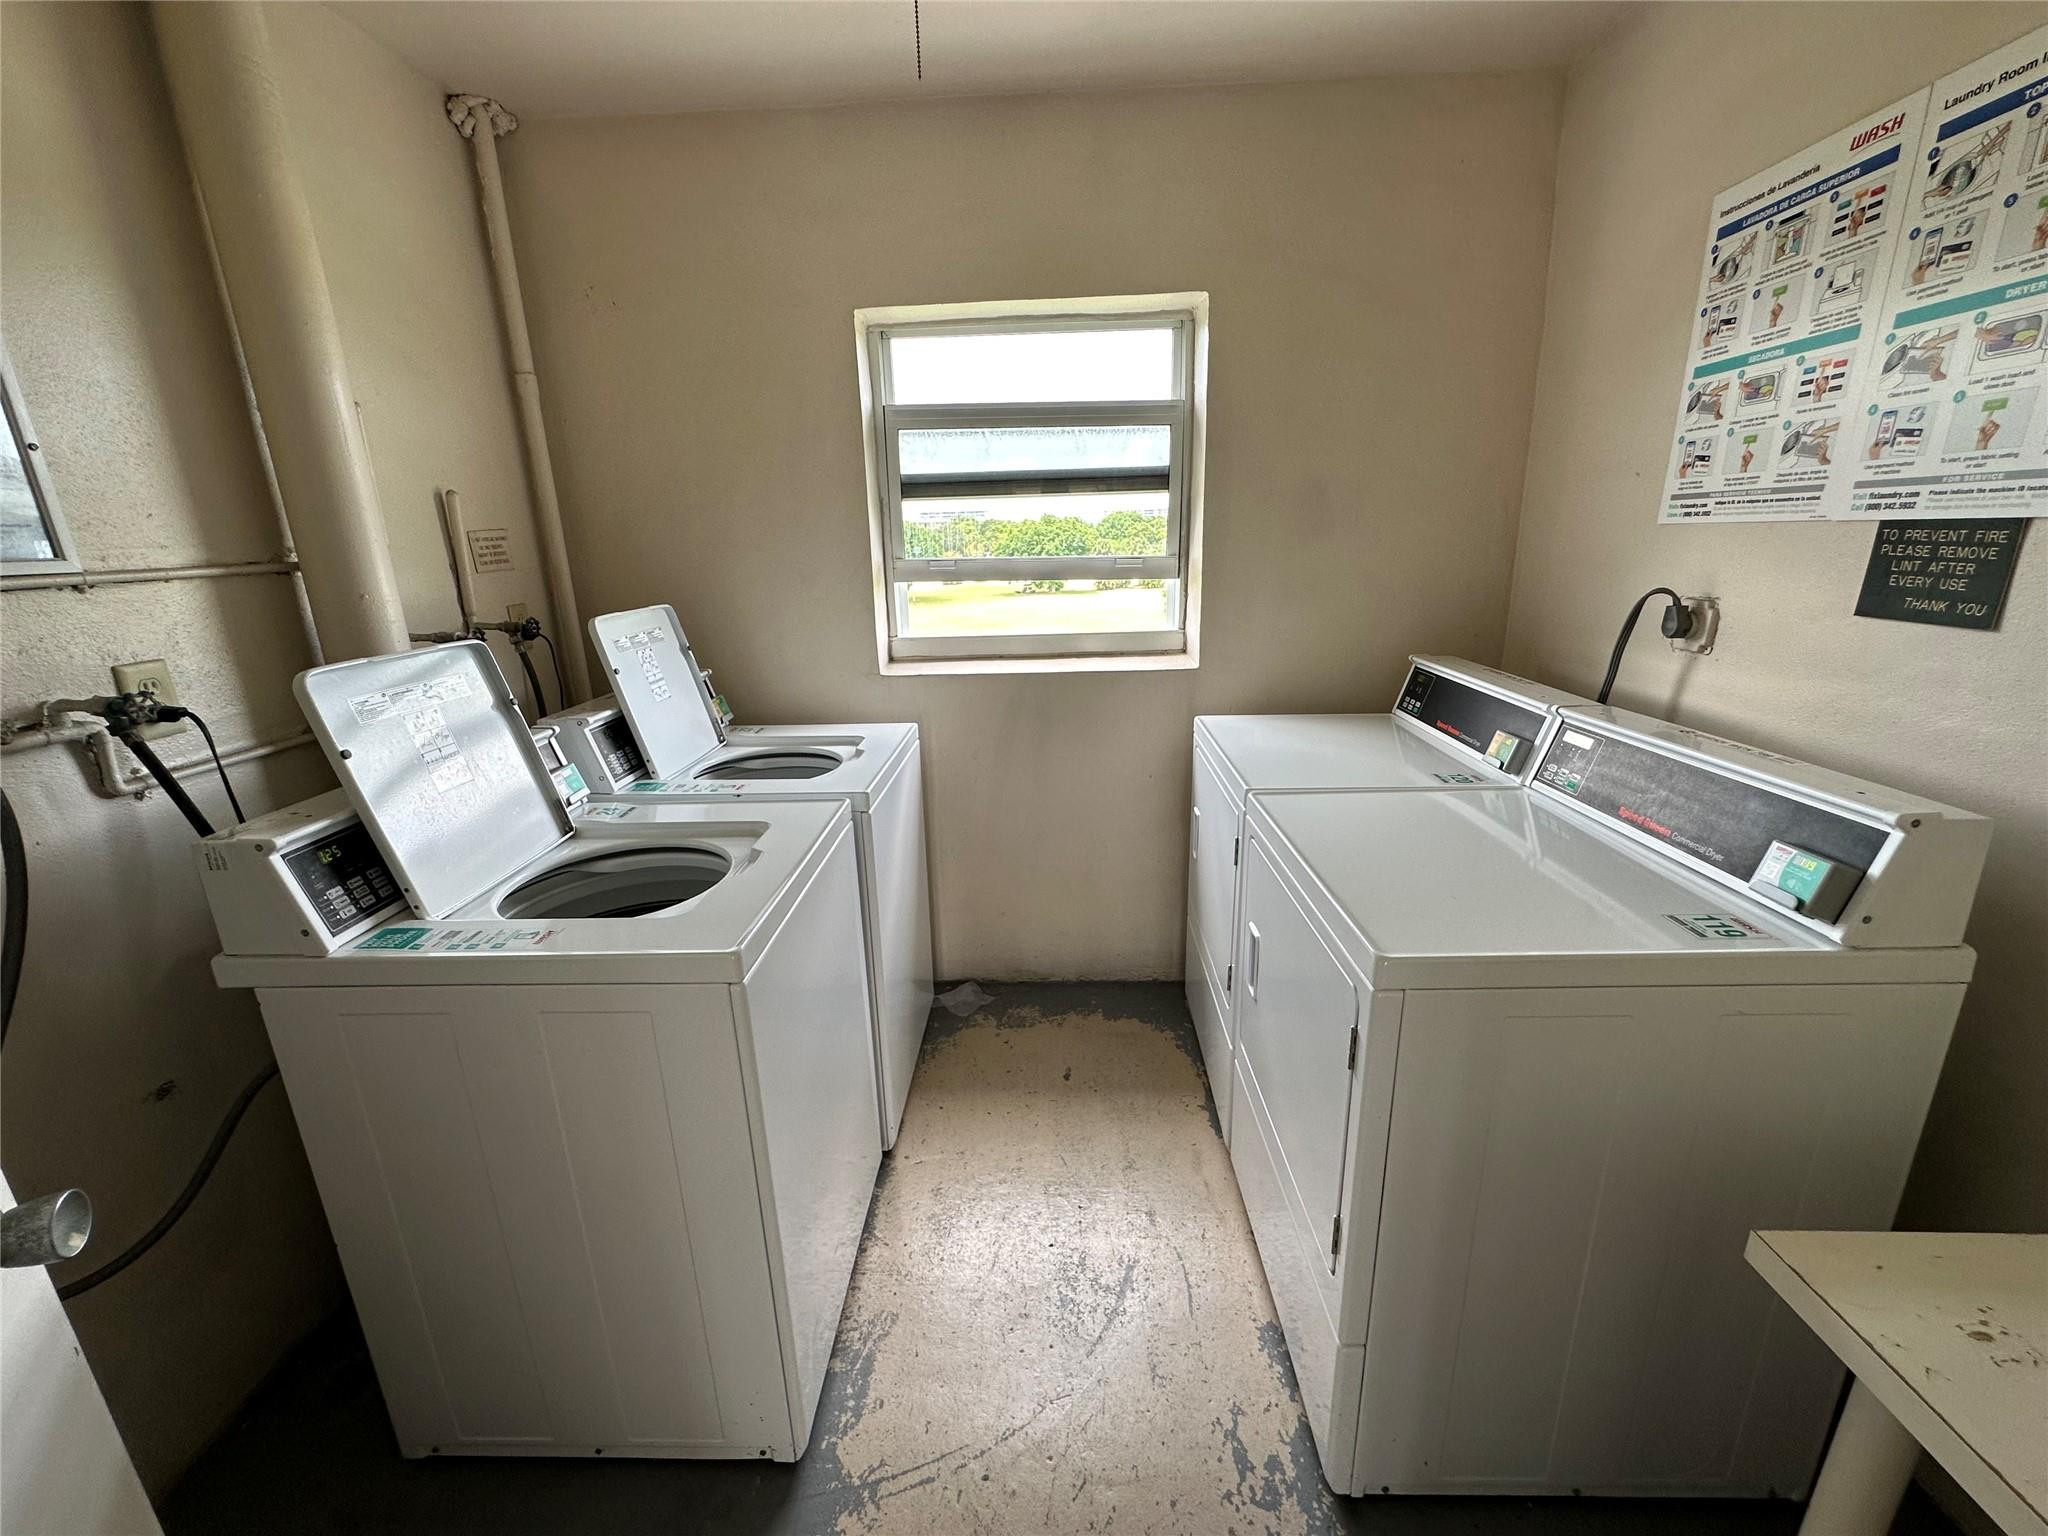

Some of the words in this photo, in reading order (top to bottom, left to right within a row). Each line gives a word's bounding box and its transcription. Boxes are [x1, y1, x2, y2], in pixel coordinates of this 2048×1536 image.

[1944, 78, 1996, 110] Laundry
[1998, 59, 2039, 85] Room
[1849, 112, 1906, 151] WASH
[1791, 188, 1818, 206] CARGA
[1818, 167, 1861, 193] SUPERIOR
[1720, 191, 1766, 218] Instrucciones
[1767, 185, 1777, 196] de
[2005, 280, 2048, 299] DRYER
[1882, 529, 1899, 541] TO
[1904, 529, 1968, 542] PREVENT
[1974, 530, 2010, 543] FIRE
[1880, 544, 1932, 557] PLEASE
[1937, 546, 2000, 560] REMOVE
[1890, 560, 1922, 571] LINT
[1928, 562, 1976, 575] AFTER
[1888, 574, 1934, 587] EVERY
[1939, 578, 1968, 591] USE
[1903, 597, 1950, 613] THANK
[1956, 602, 1988, 617] YOU
[1618, 806, 1644, 826] Speed
[1644, 818, 1672, 838] Queen
[1671, 831, 1706, 854] Commercial
[1705, 847, 1725, 862] Dryer
[1692, 914, 1748, 937] 119
